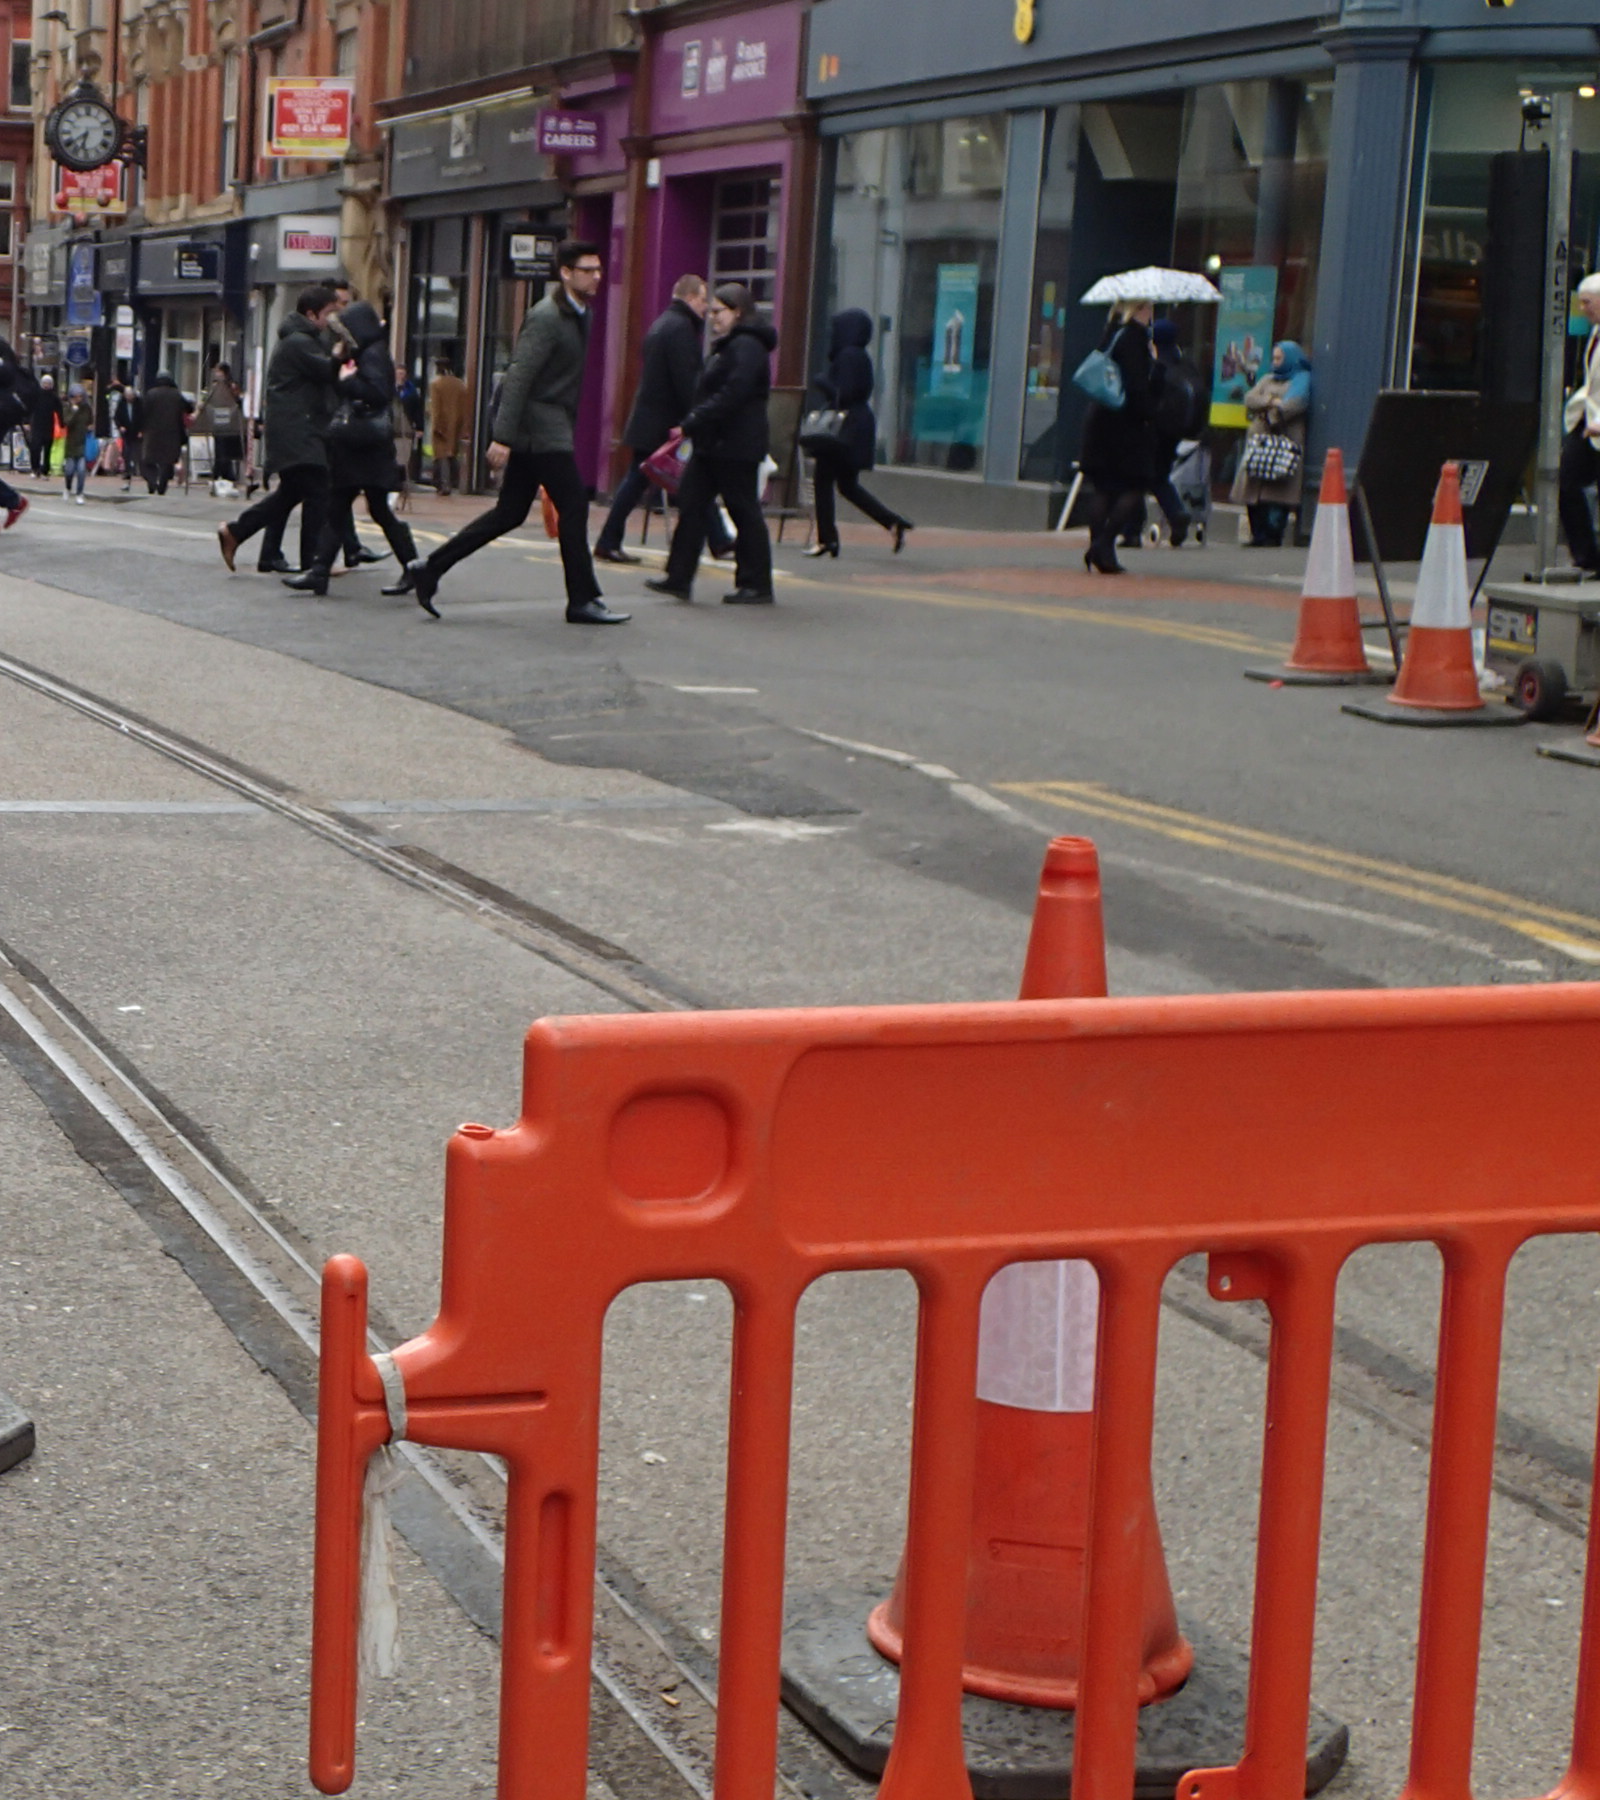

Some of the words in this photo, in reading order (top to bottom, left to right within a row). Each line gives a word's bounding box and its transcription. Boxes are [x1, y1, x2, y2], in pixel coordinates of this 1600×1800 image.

[544, 133, 596, 147] CAREERS
[290, 235, 331, 250] STUDIO
[1490, 608, 1531, 642] SRL
